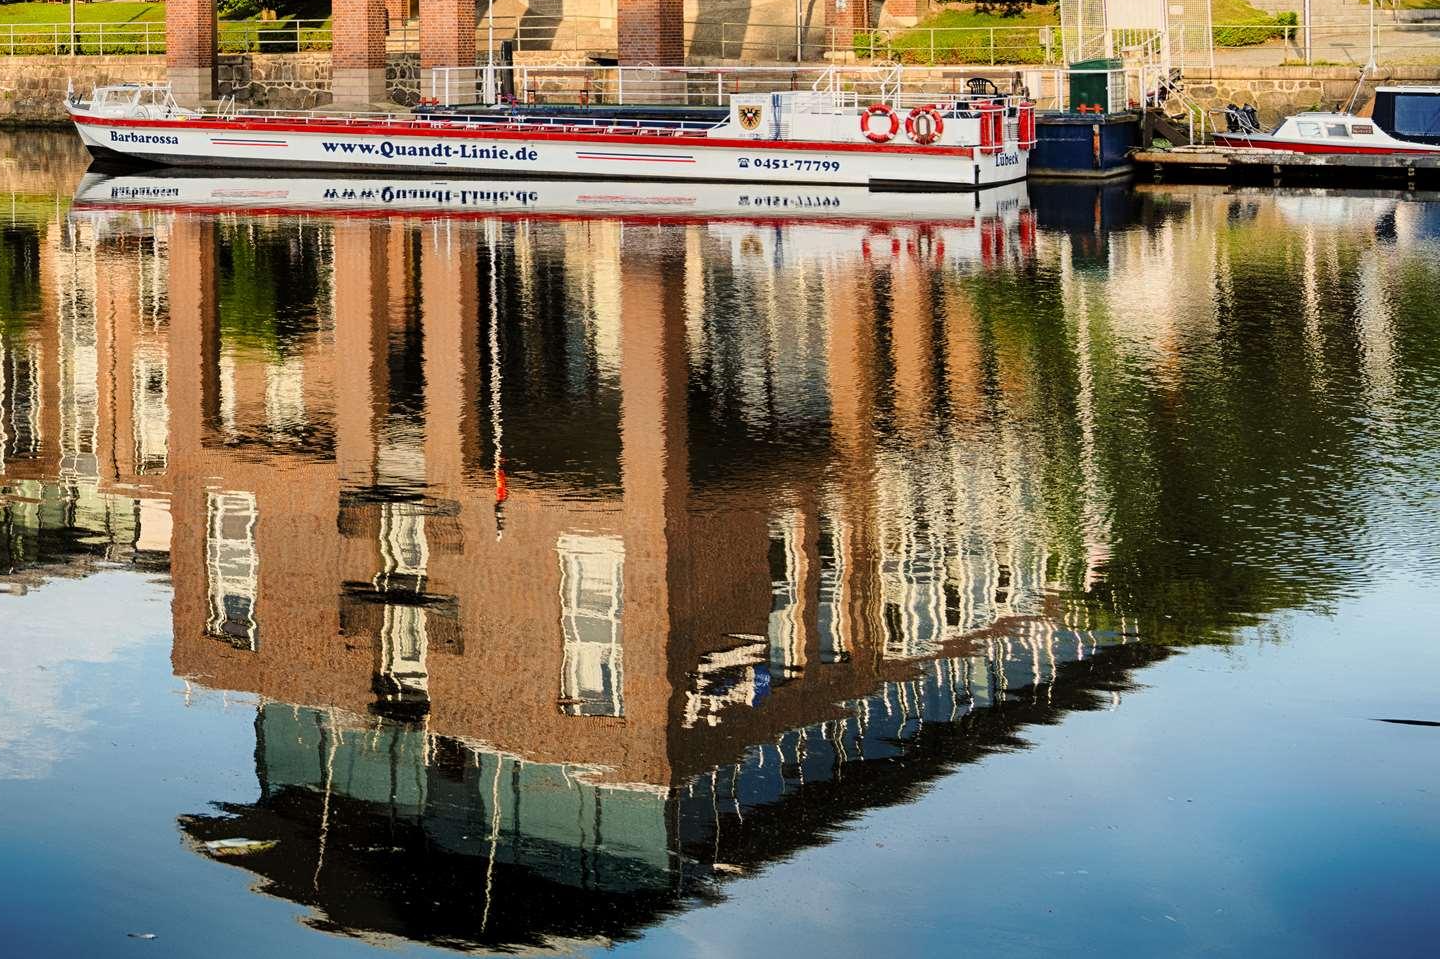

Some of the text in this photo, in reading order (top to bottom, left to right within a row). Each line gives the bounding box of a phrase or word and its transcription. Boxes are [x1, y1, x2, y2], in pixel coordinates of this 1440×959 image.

[110, 130, 179, 145] Barbarossa
[322, 141, 538, 161] www.Quandt-Linie.de
[754, 158, 840, 172] 0451-77799
[995, 152, 1019, 167] Lübeck
